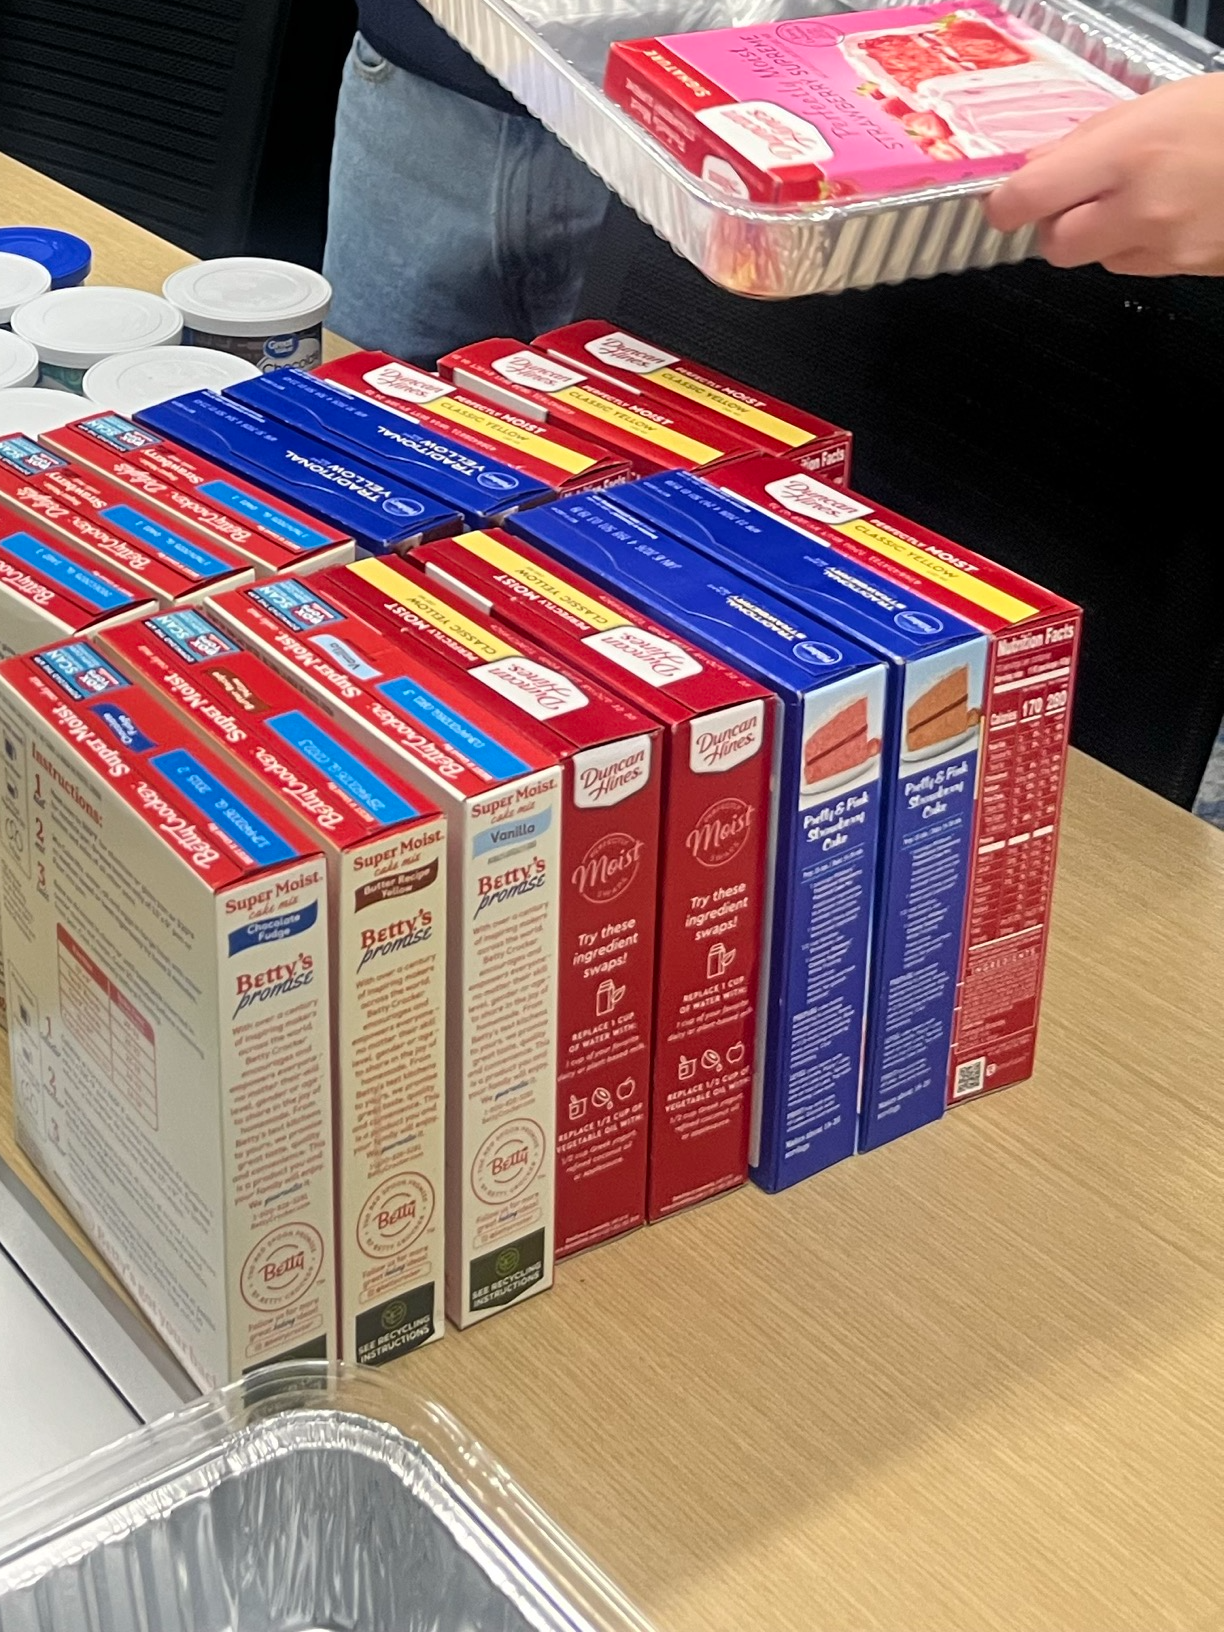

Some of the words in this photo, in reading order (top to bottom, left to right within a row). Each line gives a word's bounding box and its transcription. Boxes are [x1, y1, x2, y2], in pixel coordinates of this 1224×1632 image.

[739, 33, 808, 77] SUPREME
[800, 78, 904, 150] STRAWBERRY
[509, 356, 569, 383] Duncan
[602, 338, 664, 366] Duncan
[379, 368, 437, 395] Duncan
[661, 371, 708, 399] CLASSIC
[706, 392, 752, 415] YELLOW
[721, 386, 767, 409] MOIST
[439, 401, 485, 426] CLASSIC
[484, 420, 530, 442] YELLOW
[499, 412, 547, 436] MOIST
[569, 389, 616, 417] CLASSIC
[614, 411, 659, 434] YELLOW
[628, 403, 674, 426] MOIST
[141, 448, 203, 484] Strawberry
[377, 425, 475, 477] TRADITIONAL
[420, 439, 484, 472] YELLOW
[47, 472, 107, 509] Strawberry
[284, 450, 381, 503] TRADITIONAL
[327, 463, 392, 499] YELLOW
[789, 480, 859, 515] Duncan
[854, 524, 906, 556] CLASSIC
[905, 549, 959, 580] YELLOW
[925, 545, 979, 573] MOIST
[493, 574, 541, 604] MOIST
[514, 568, 560, 599] YELLOW
[384, 603, 430, 635] MOIST
[407, 596, 450, 626] YELLOW
[560, 596, 608, 625] CLASSIC
[449, 627, 497, 656] CLASSIC
[1045, 624, 1075, 646] Facts
[602, 635, 675, 677] Duncan
[316, 664, 361, 700] Super
[487, 665, 569, 710] Duncan
[204, 706, 247, 743] Super
[697, 715, 757, 755] Duncan
[90, 735, 131, 778] Super
[580, 749, 645, 790] Duncan
[32, 742, 103, 828] Instructions:
[472, 794, 513, 818] Super
[490, 823, 536, 844] Vanilla
[686, 805, 755, 856] Moist
[353, 848, 398, 872] Super
[478, 855, 546, 896] Betty's
[571, 840, 644, 894] Moist
[363, 876, 398, 896] Butter
[399, 867, 431, 886] Recipe
[381, 884, 414, 899] Yellow
[474, 872, 546, 920] promise
[690, 895, 711, 911] Try
[713, 882, 747, 902] these
[225, 891, 273, 915] Super
[685, 897, 749, 928] ingredient
[247, 914, 301, 935] Chocolate
[258, 926, 291, 943] Fudge
[361, 908, 433, 950] Betty's
[695, 917, 738, 942] swaps!
[356, 926, 433, 974] promise
[236, 953, 314, 995] Betty's
[232, 970, 314, 1020] promise
[373, 1200, 417, 1230] Betty
[258, 1250, 305, 1282] Betty
[491, 1261, 542, 1293] RECYCLING
[473, 1270, 540, 1309] INSTRUCTIONS
[358, 1339, 376, 1354] SEE
[378, 1314, 431, 1347] RECYCLING
[360, 1325, 431, 1363] INSTRUCTIONS
